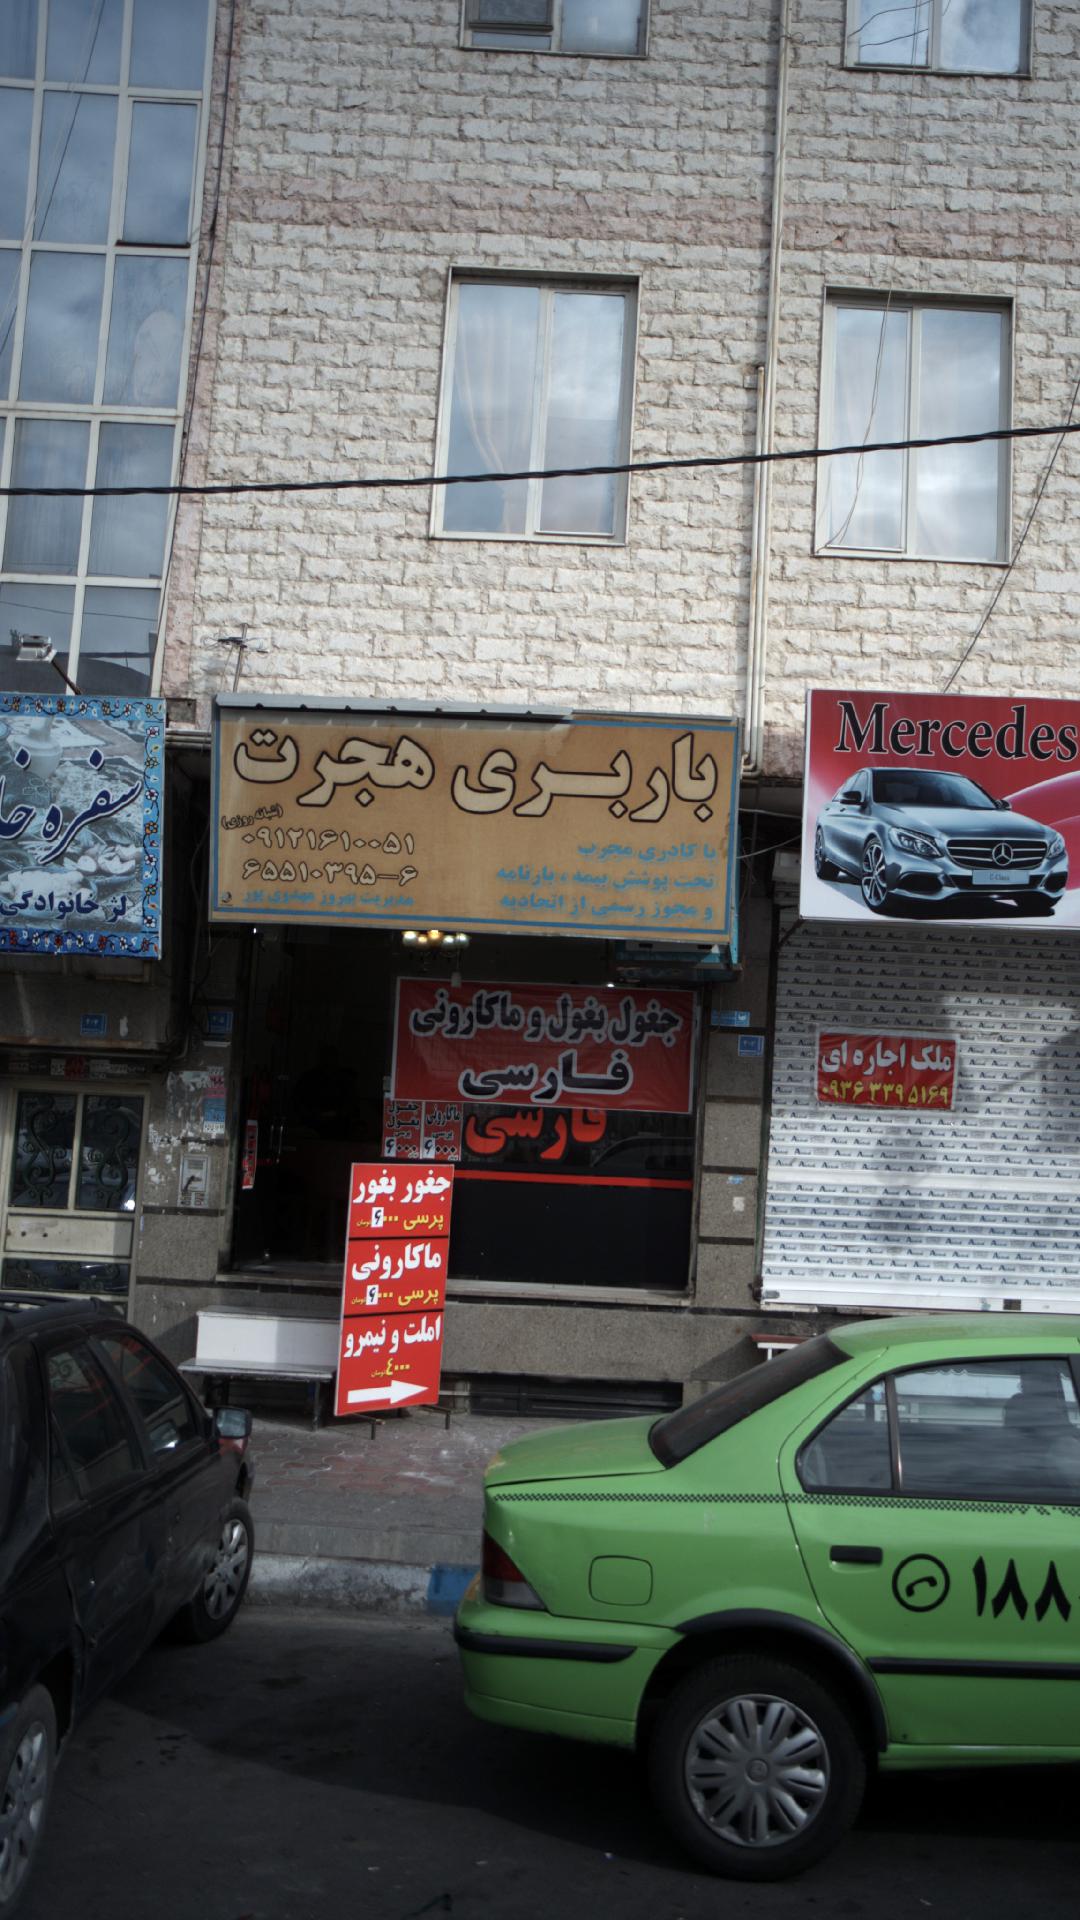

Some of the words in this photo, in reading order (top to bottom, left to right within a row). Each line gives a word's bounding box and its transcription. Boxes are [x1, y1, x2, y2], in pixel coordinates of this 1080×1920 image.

[833, 700, 1079, 761] Mercedes
[234, 729, 435, 807] هجرت
[451, 732, 718, 822] باربری
[37, 748, 142, 865] سفره
[242, 826, 415, 855] ۰۹۱۲۱۶۱۰۰۵۱
[0, 890, 99, 919] خانوادگی
[410, 989, 522, 1036] ماکارونی
[524, 1007, 545, 1041] و
[548, 993, 608, 1042] بغول
[608, 996, 682, 1047] جغول
[821, 1039, 848, 1072] ای
[853, 1040, 906, 1075] اجاره
[911, 1044, 951, 1071] ملک
[459, 1049, 633, 1101] فارسی
[353, 1169, 397, 1203] بغور
[400, 1169, 451, 1204] جغور
[403, 1213, 444, 1231] پرسی
[351, 1243, 441, 1280] ماکارونی
[397, 1289, 439, 1306] پرسی
[343, 1319, 386, 1358] نیمرو
[389, 1334, 398, 1354] و
[404, 1315, 441, 1345] املت
[972, 1556, 1080, 1622] ۱۸۸
